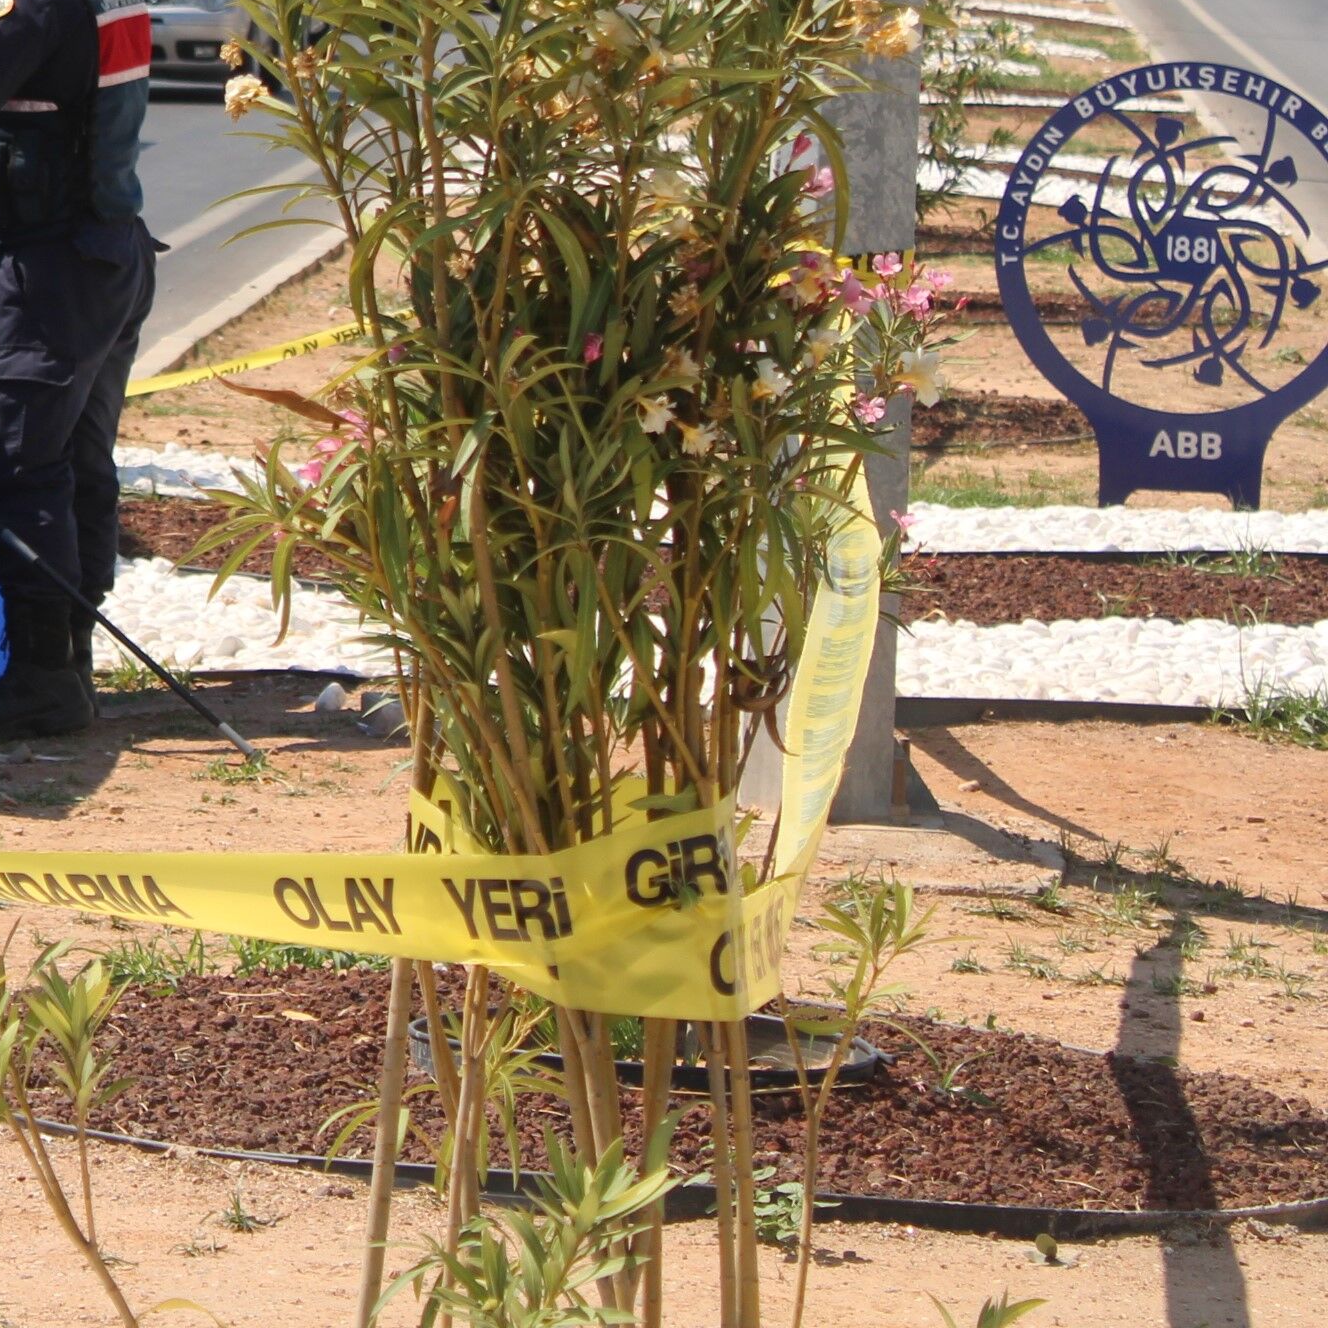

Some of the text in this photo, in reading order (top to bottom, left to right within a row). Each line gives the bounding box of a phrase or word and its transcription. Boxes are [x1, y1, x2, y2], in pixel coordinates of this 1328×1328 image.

[1013, 125, 1065, 207] AYDIN
[1166, 235, 1217, 265] 1881
[1149, 429, 1222, 460] ABB
[272, 876, 403, 936] OLAY
